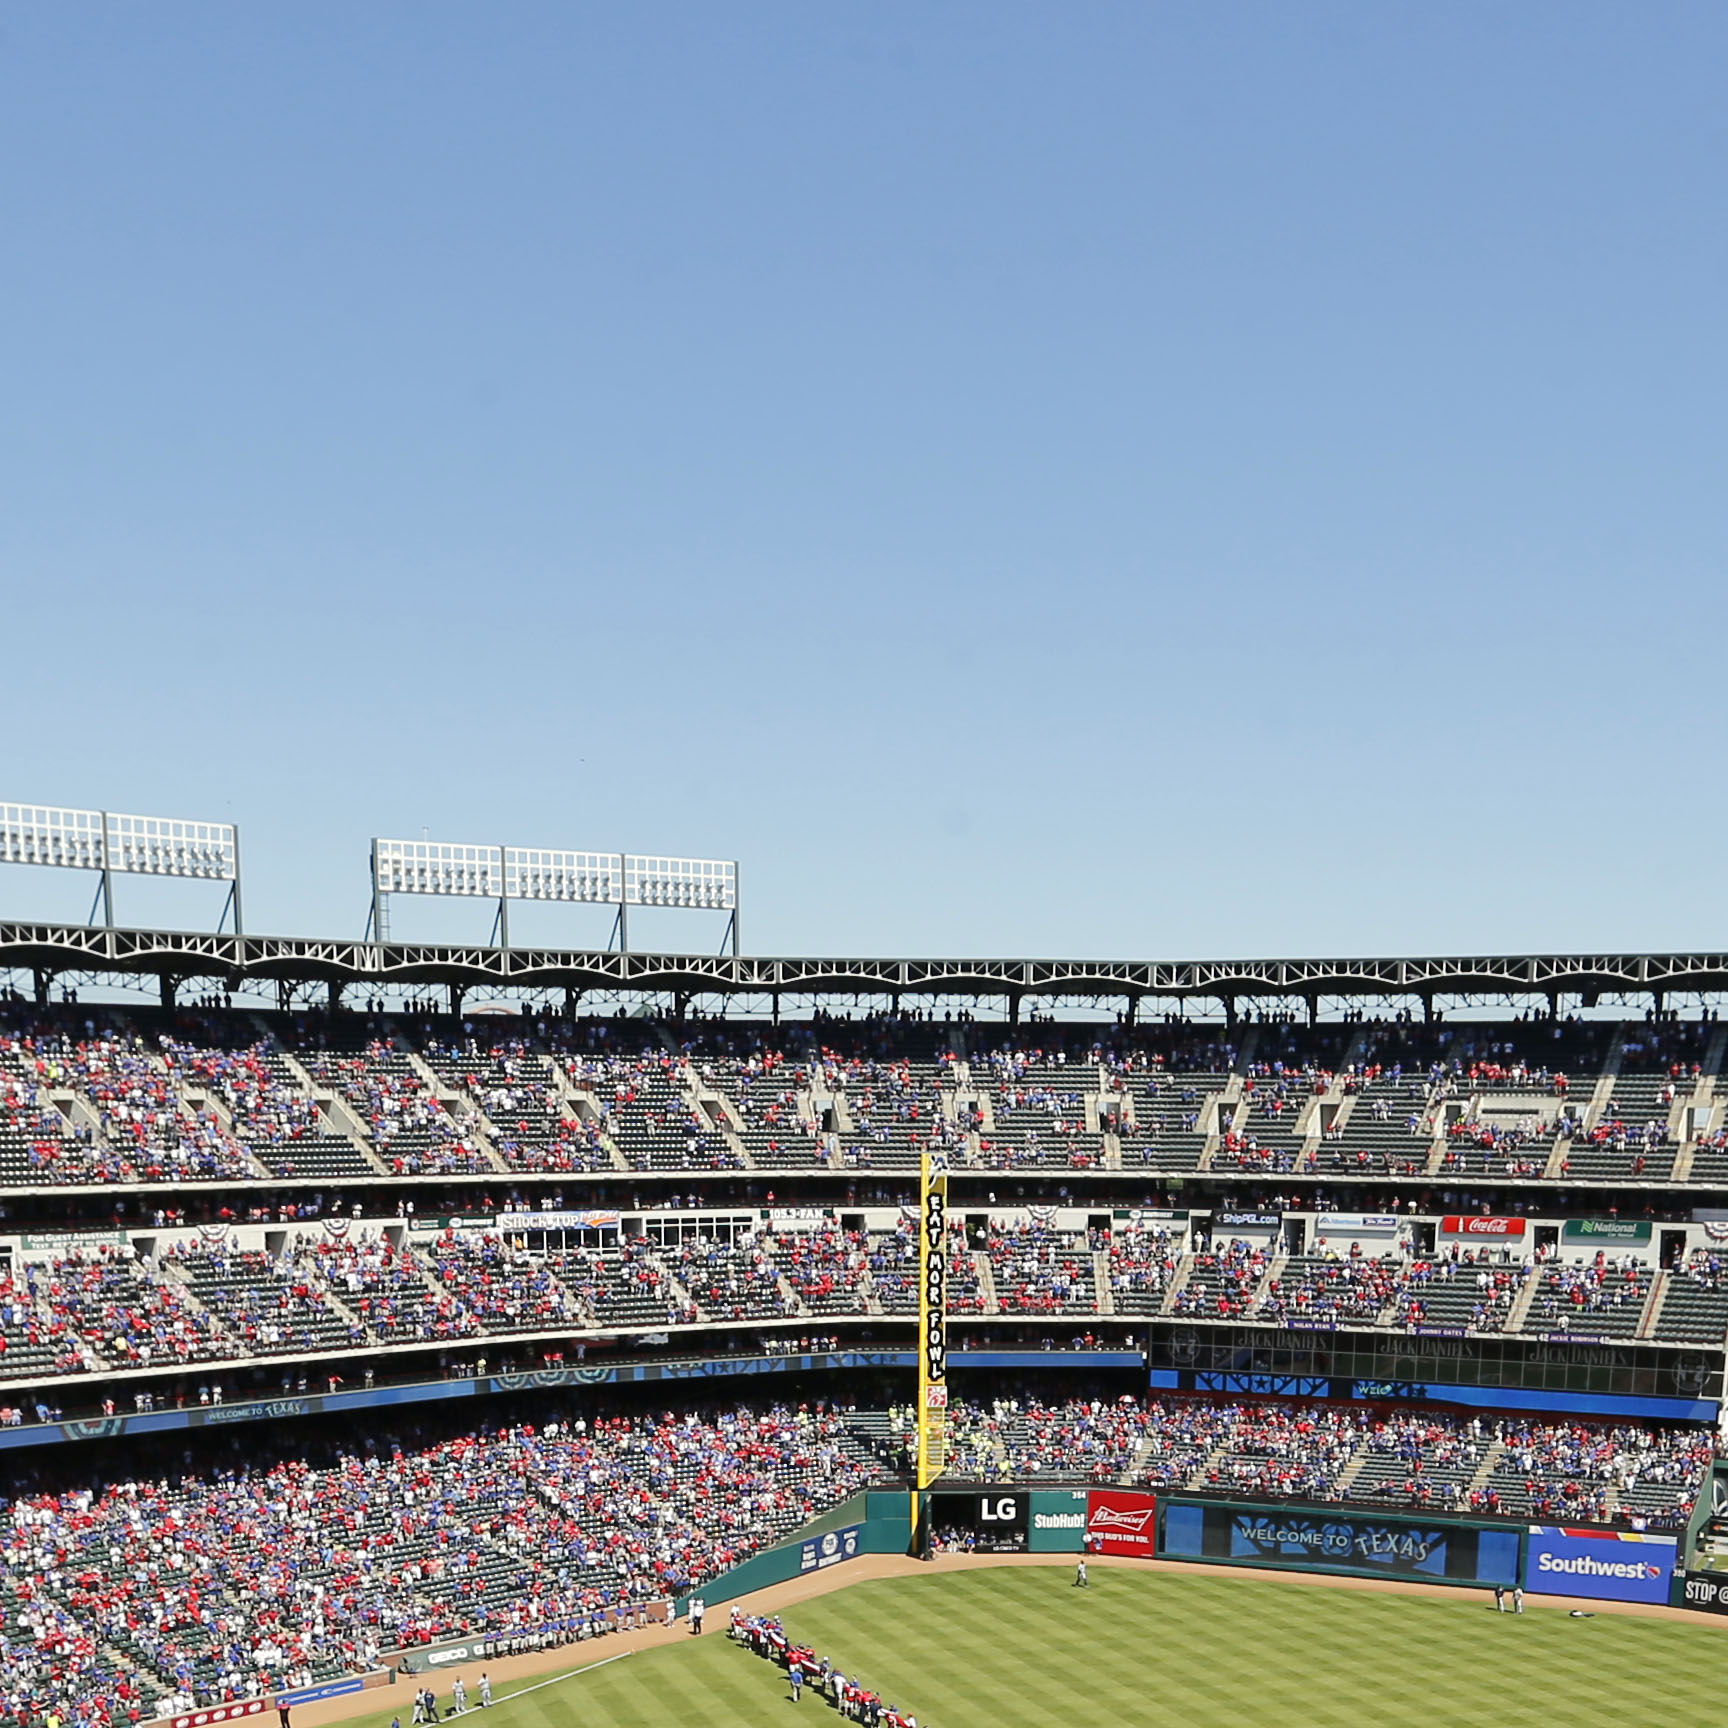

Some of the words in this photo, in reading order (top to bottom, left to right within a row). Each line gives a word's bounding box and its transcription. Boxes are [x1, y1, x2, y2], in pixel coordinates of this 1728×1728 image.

[502, 1214, 547, 1229] SHOCK
[555, 1214, 579, 1227] TOP
[800, 1208, 823, 1219] FAN
[928, 1196, 942, 1245] EAT
[1223, 1213, 1279, 1226] ShipPGL.com
[1468, 1217, 1510, 1233] Coca-Cola
[1593, 1221, 1638, 1233] National
[28, 1234, 45, 1243] FOR
[45, 1233, 73, 1243] GUEST
[928, 1255, 943, 1304] MOR
[928, 1313, 945, 1379] FOWL
[1238, 1329, 1272, 1348] JACK
[1381, 1337, 1417, 1355] JACK
[1529, 1346, 1567, 1363] JACK
[207, 1409, 250, 1421] WELCOME
[252, 1407, 263, 1416] TO
[265, 1402, 302, 1417] TEXAS
[981, 1498, 1017, 1520] LG
[1095, 1510, 1147, 1525] Budweiser
[1034, 1514, 1086, 1528] StubHub!
[1242, 1527, 1323, 1545] WELCOME
[1326, 1534, 1348, 1547] TO
[1355, 1533, 1430, 1561] TEXAS
[1538, 1553, 1646, 1580] Southwest
[1685, 1580, 1718, 1602] STOP
[427, 1647, 468, 1664] GEICO
